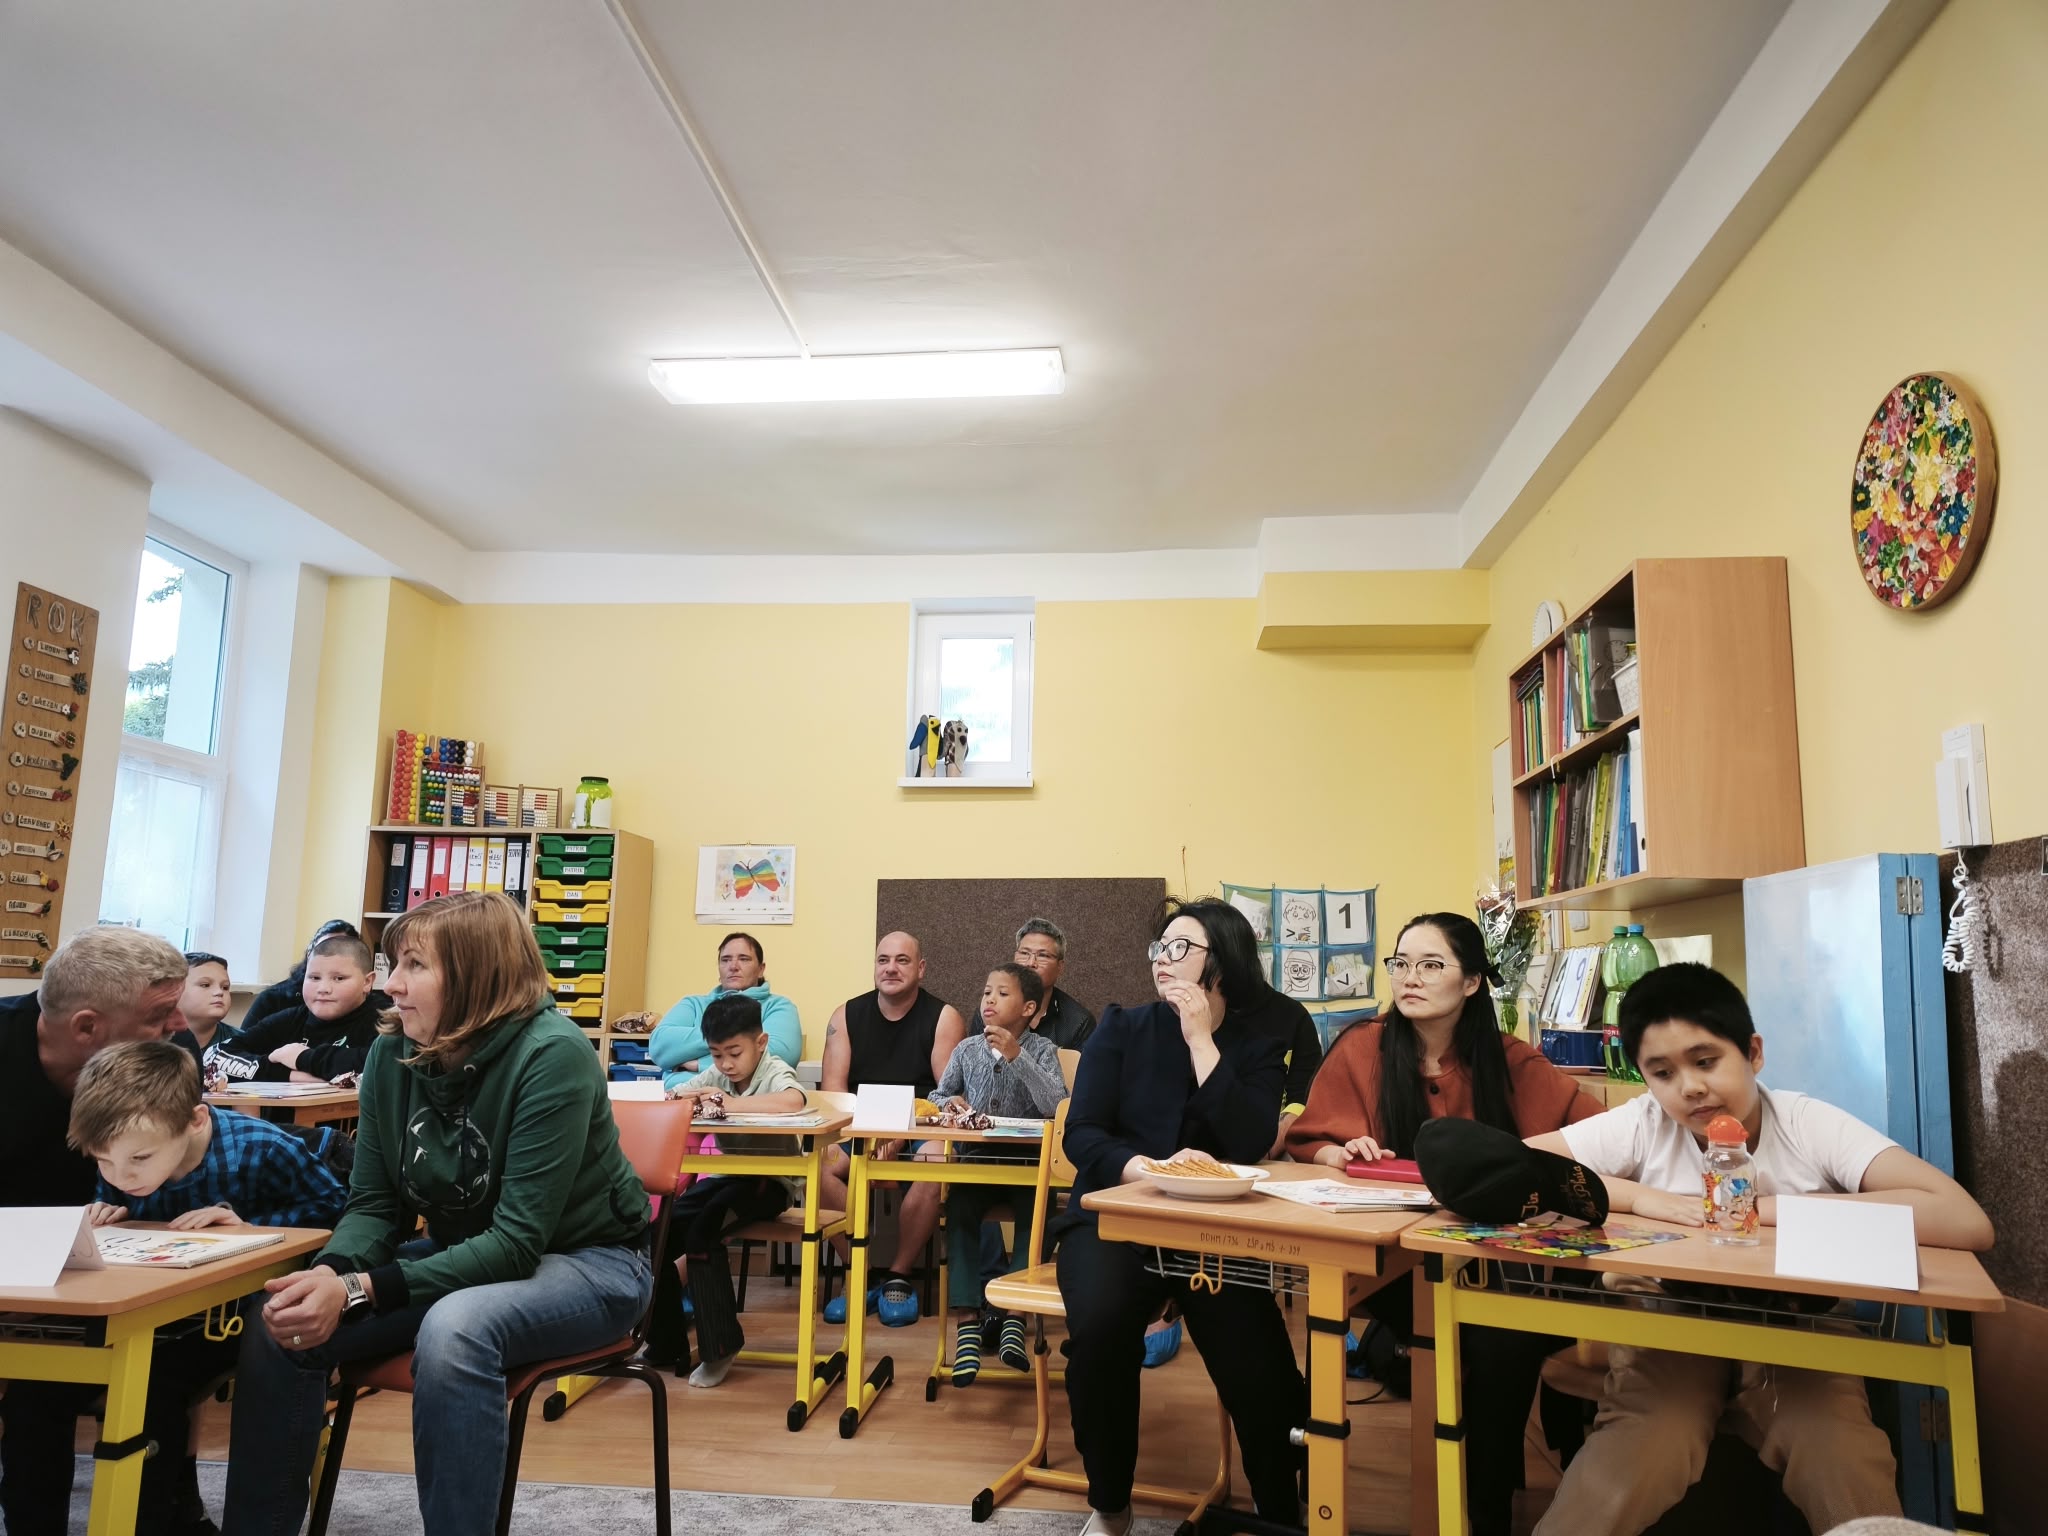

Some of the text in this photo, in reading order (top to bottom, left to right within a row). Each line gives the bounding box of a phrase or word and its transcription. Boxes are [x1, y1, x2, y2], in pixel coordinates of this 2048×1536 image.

[27, 592, 86, 647] ROK
[566, 890, 579, 898] DAN
[1338, 902, 1352, 930] 1
